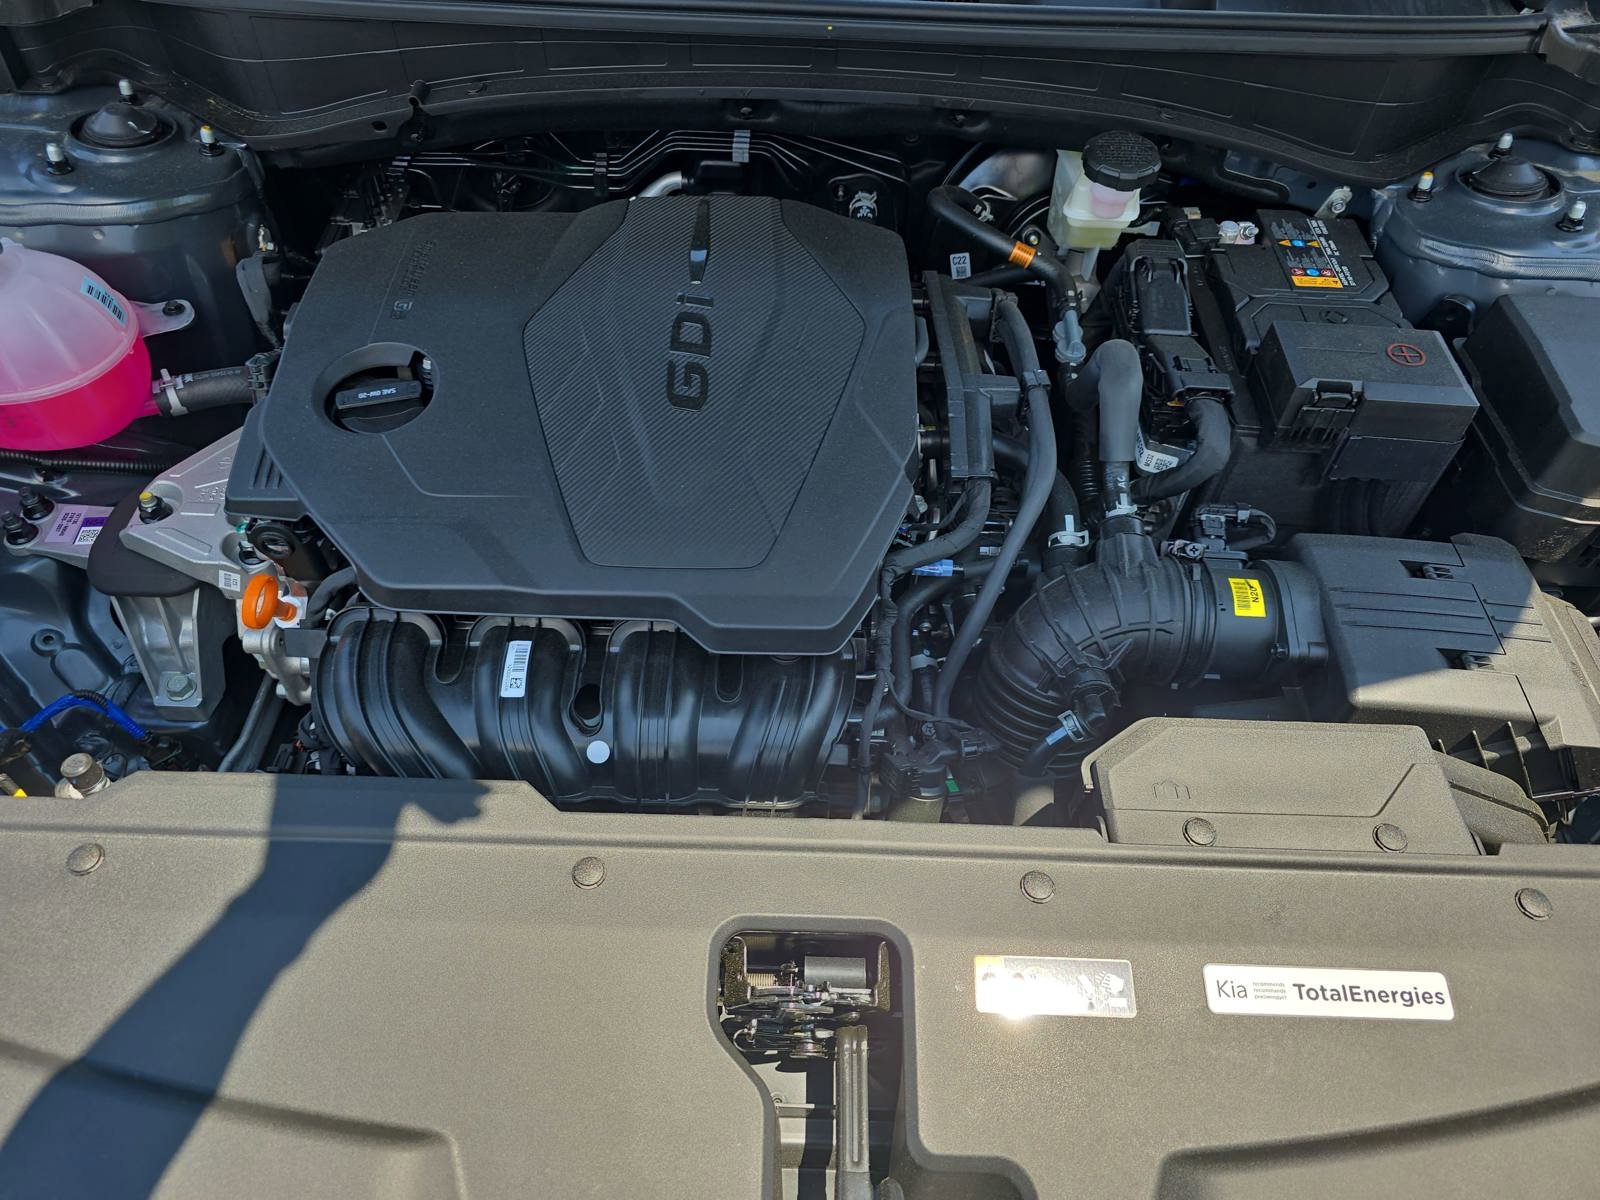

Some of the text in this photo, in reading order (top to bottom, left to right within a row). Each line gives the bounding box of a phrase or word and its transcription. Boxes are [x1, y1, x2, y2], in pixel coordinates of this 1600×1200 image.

[952, 255, 967, 266] C22
[666, 292, 714, 412] GDi
[1216, 979, 1248, 999] Kia
[1292, 983, 1446, 1008] TotalEnergies
